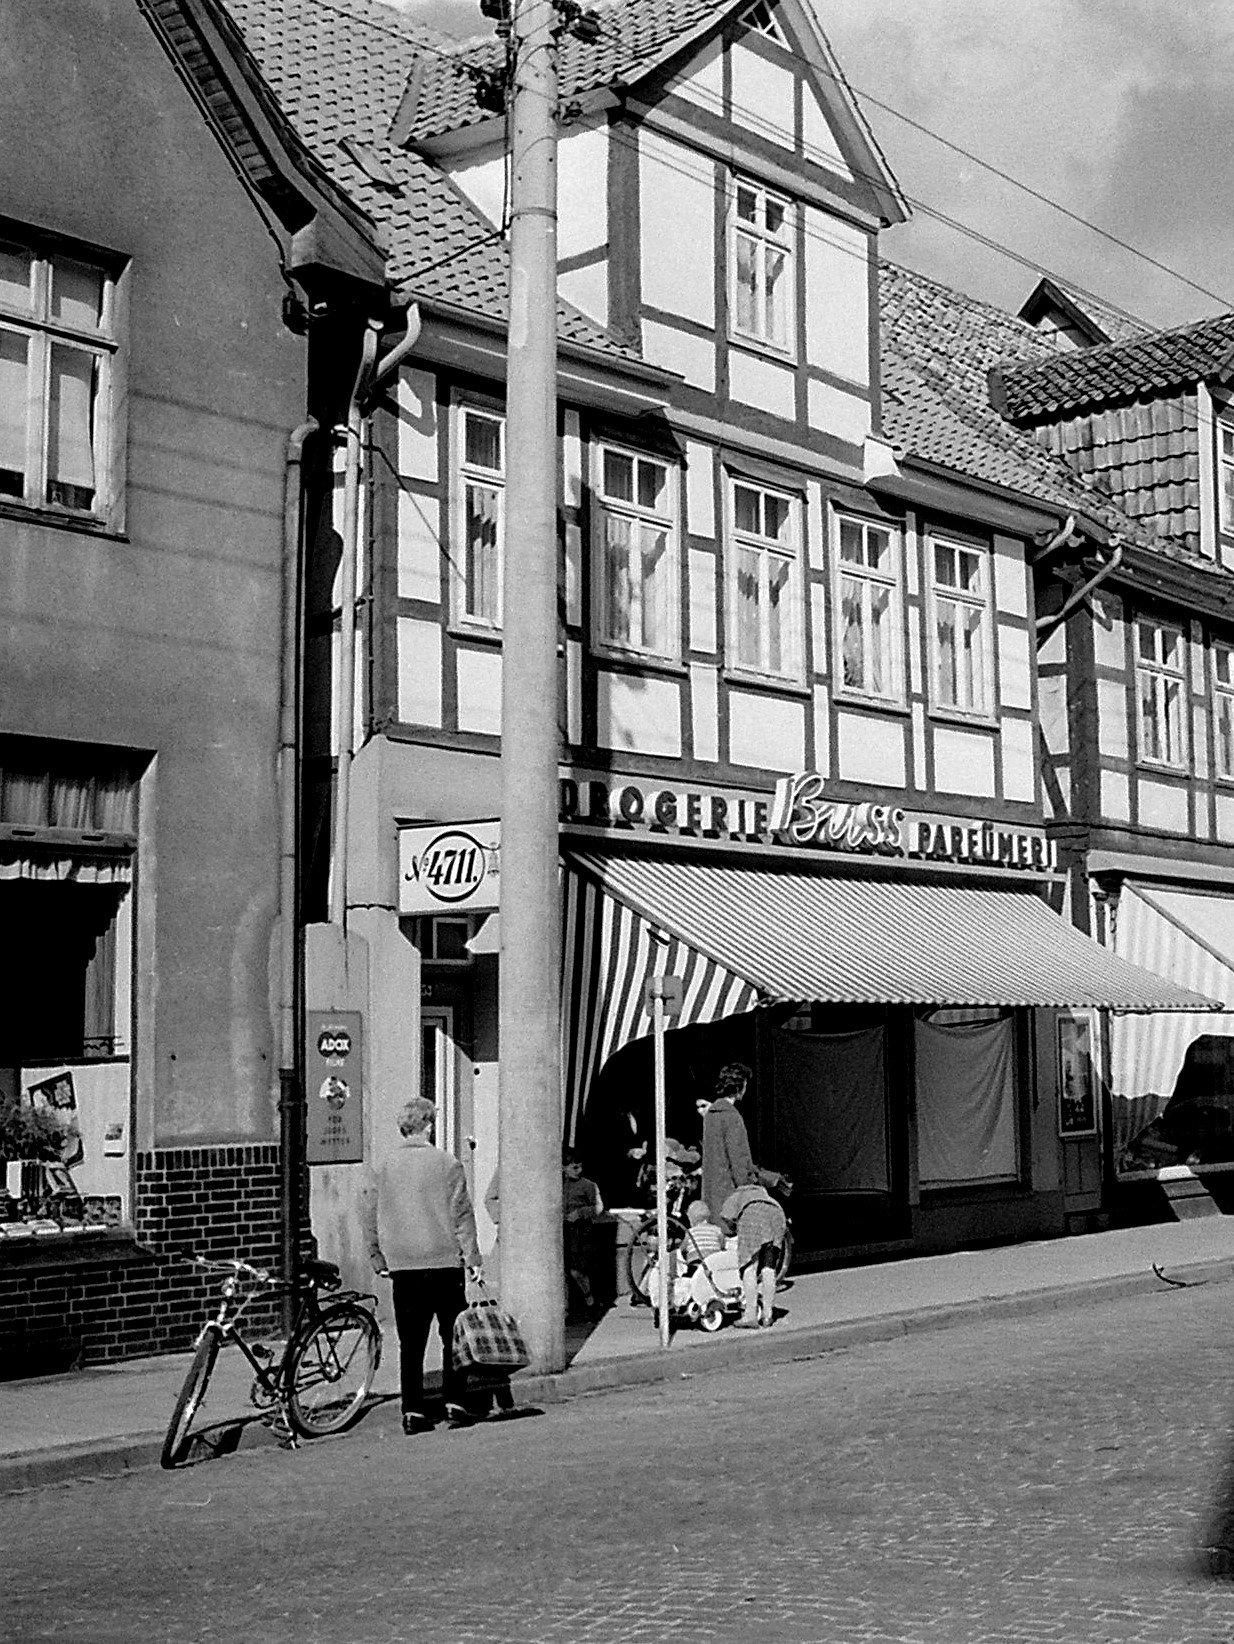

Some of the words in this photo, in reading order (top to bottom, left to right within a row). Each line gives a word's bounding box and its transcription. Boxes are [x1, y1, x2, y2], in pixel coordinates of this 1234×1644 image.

[559, 778, 768, 835] DROGERIE
[779, 774, 905, 847] Buss
[916, 821, 1064, 869] PARFÜMERI
[321, 1038, 350, 1051] ADOX
